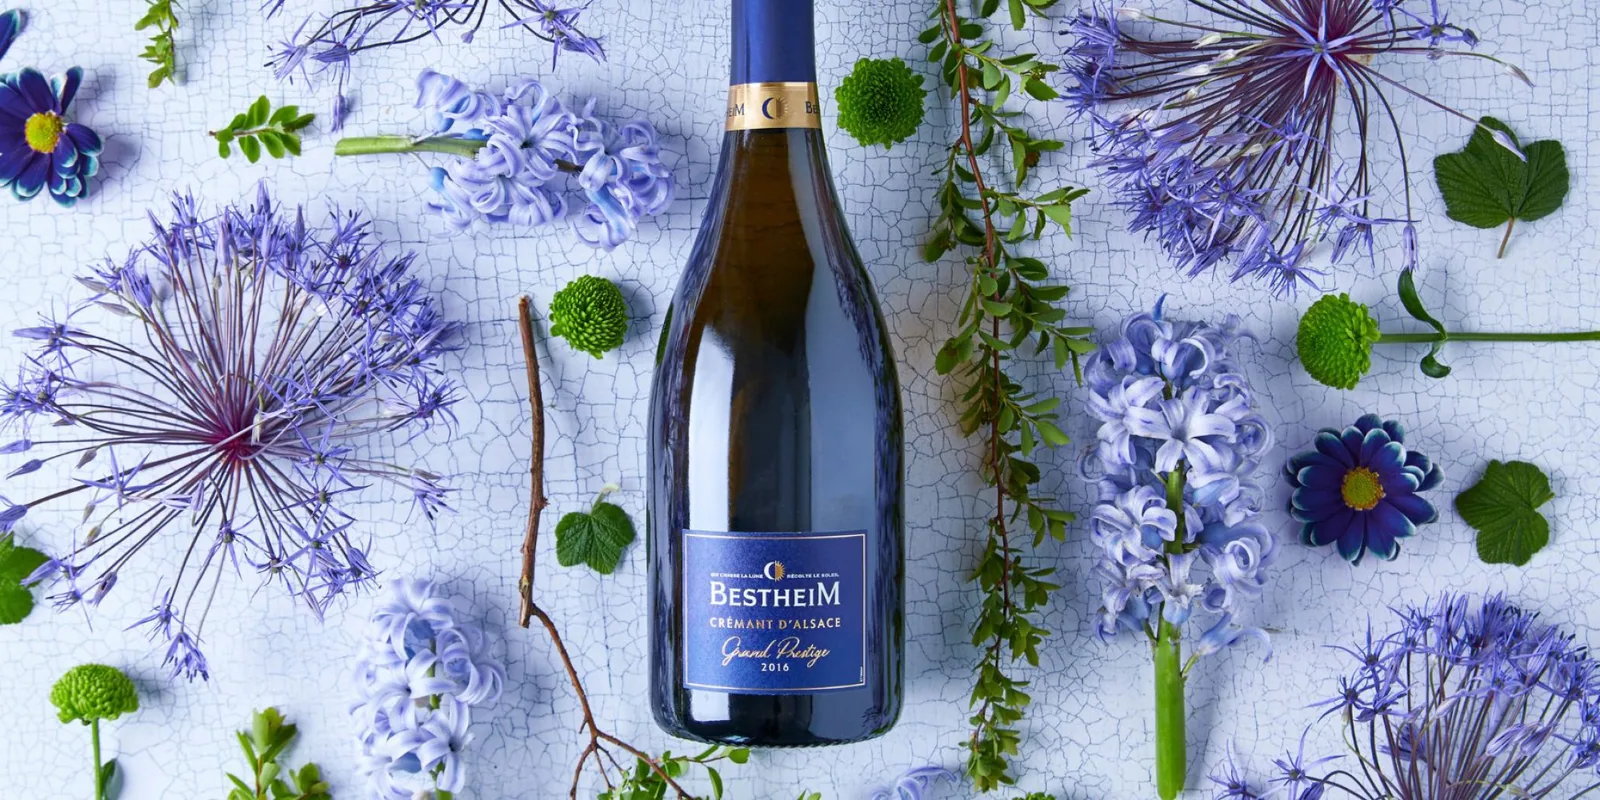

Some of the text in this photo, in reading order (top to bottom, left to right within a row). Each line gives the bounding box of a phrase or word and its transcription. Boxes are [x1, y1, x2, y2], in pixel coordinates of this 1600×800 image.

[709, 581, 841, 607] BESTHEIM
[709, 616, 841, 630] CRÉMANT D'ALSACE
[721, 635, 831, 668] Grand Prestige
[761, 662, 790, 672] 2016
